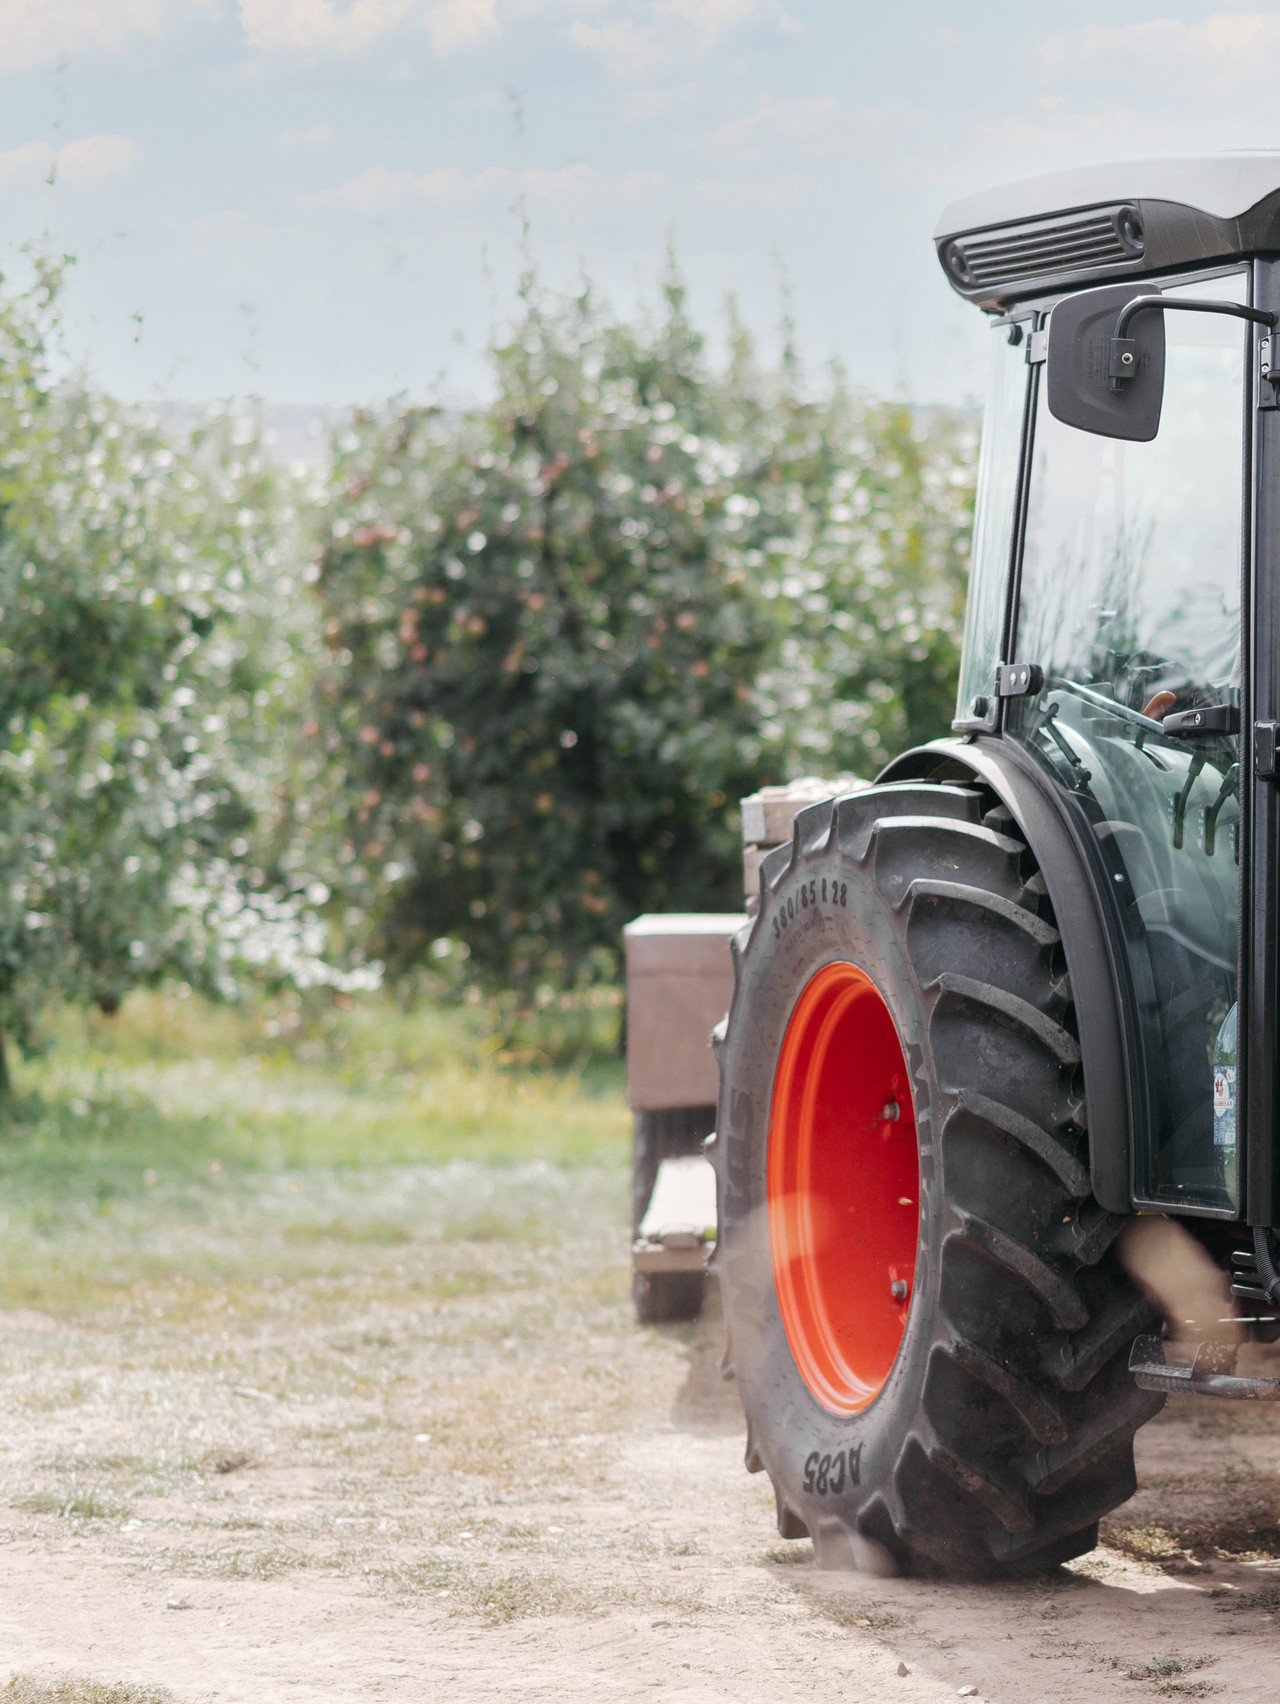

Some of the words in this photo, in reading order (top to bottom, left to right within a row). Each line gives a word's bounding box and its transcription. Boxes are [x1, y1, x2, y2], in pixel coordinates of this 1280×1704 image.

[773, 879, 816, 940] 380/85
[832, 880, 847, 908] 28
[803, 1441, 864, 1496] AC85
